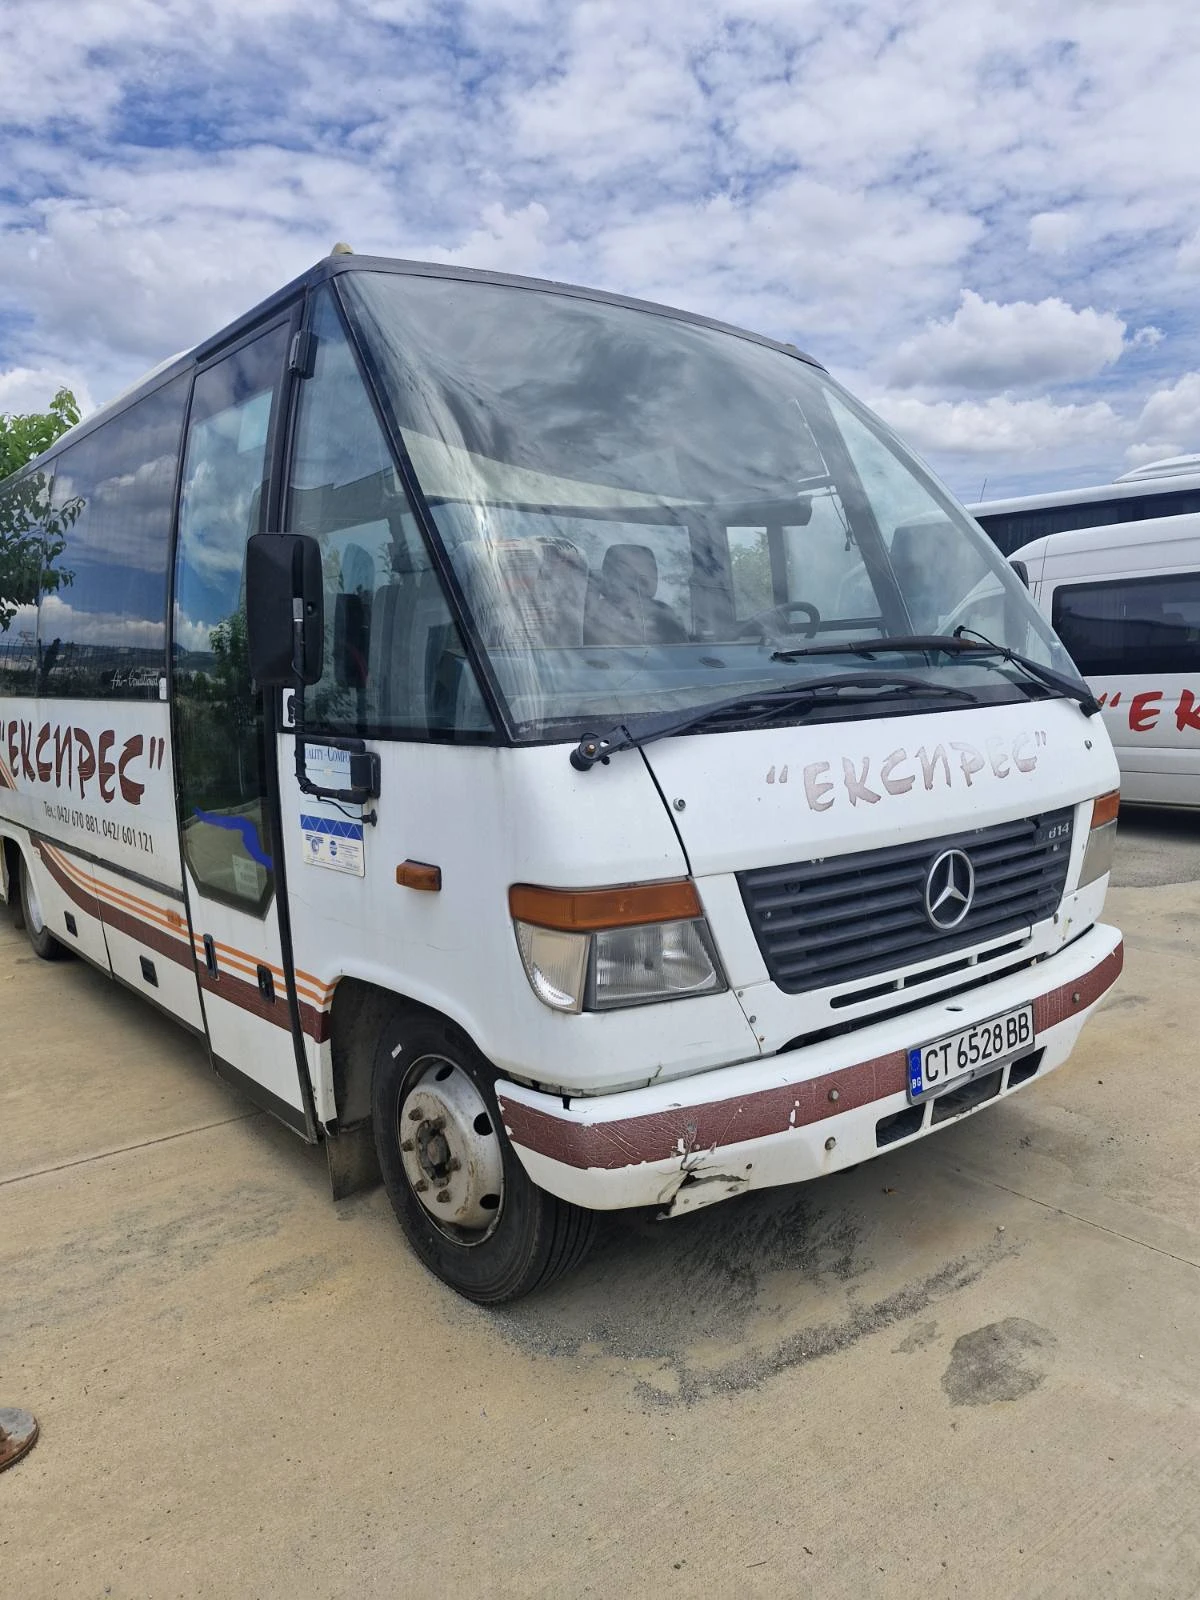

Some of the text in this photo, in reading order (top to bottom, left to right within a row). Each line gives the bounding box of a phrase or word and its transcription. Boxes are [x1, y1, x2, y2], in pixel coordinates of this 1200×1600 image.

[57, 805, 70, 824] 042/
[71, 810, 84, 829] 670
[102, 819, 120, 840] 042/
[122, 825, 137, 847] 601
[138, 831, 154, 854] 121
[925, 1012, 1030, 1082] CT 6528 BB
[911, 1077, 922, 1088] BG
